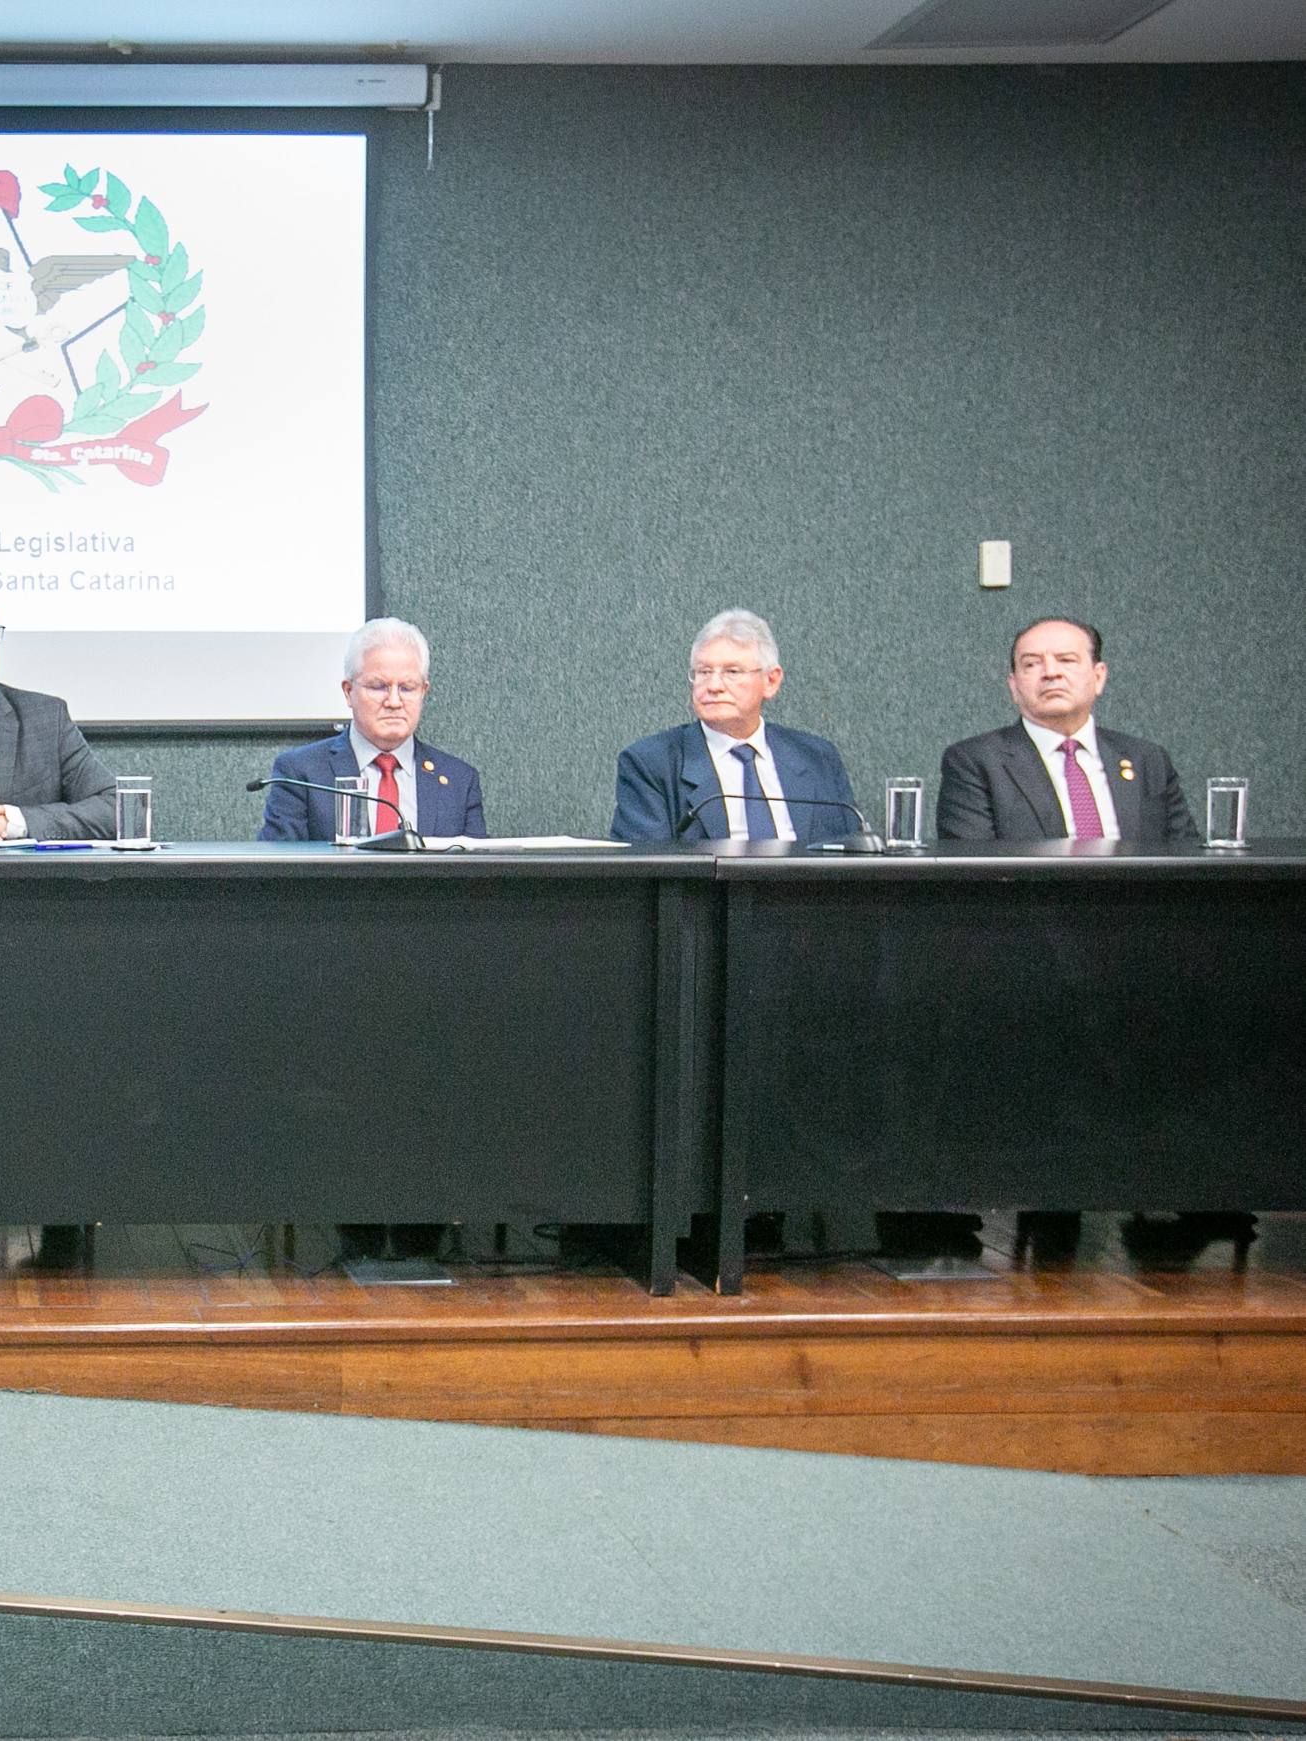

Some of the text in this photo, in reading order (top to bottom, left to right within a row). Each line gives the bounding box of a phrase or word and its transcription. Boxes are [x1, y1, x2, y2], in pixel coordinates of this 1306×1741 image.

[30, 448, 66, 461] Sta.
[70, 444, 154, 466] Catarina
[69, 571, 175, 591] Catarina
